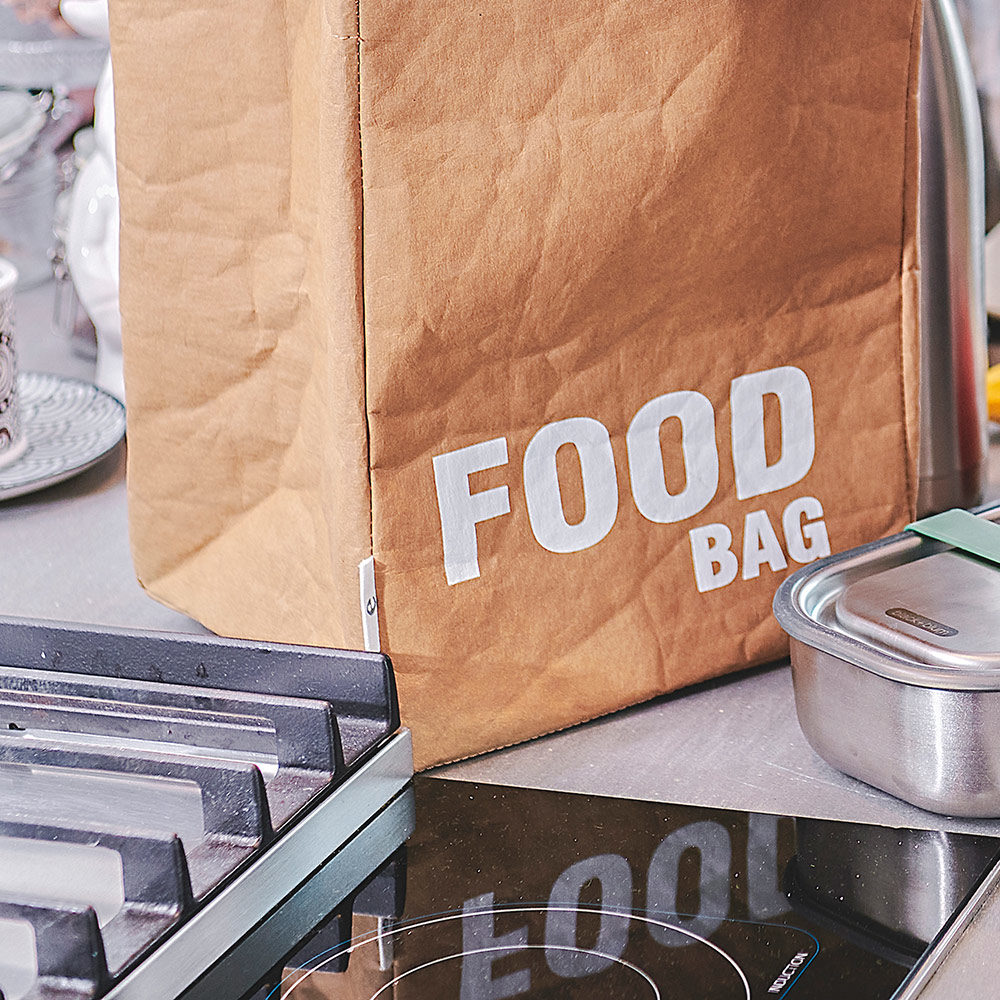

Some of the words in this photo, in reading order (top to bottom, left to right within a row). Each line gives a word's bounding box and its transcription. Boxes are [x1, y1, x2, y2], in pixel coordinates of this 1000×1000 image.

[433, 366, 816, 586] FOOD
[689, 496, 831, 593] BAG
[767, 952, 809, 993] INDUCTION
